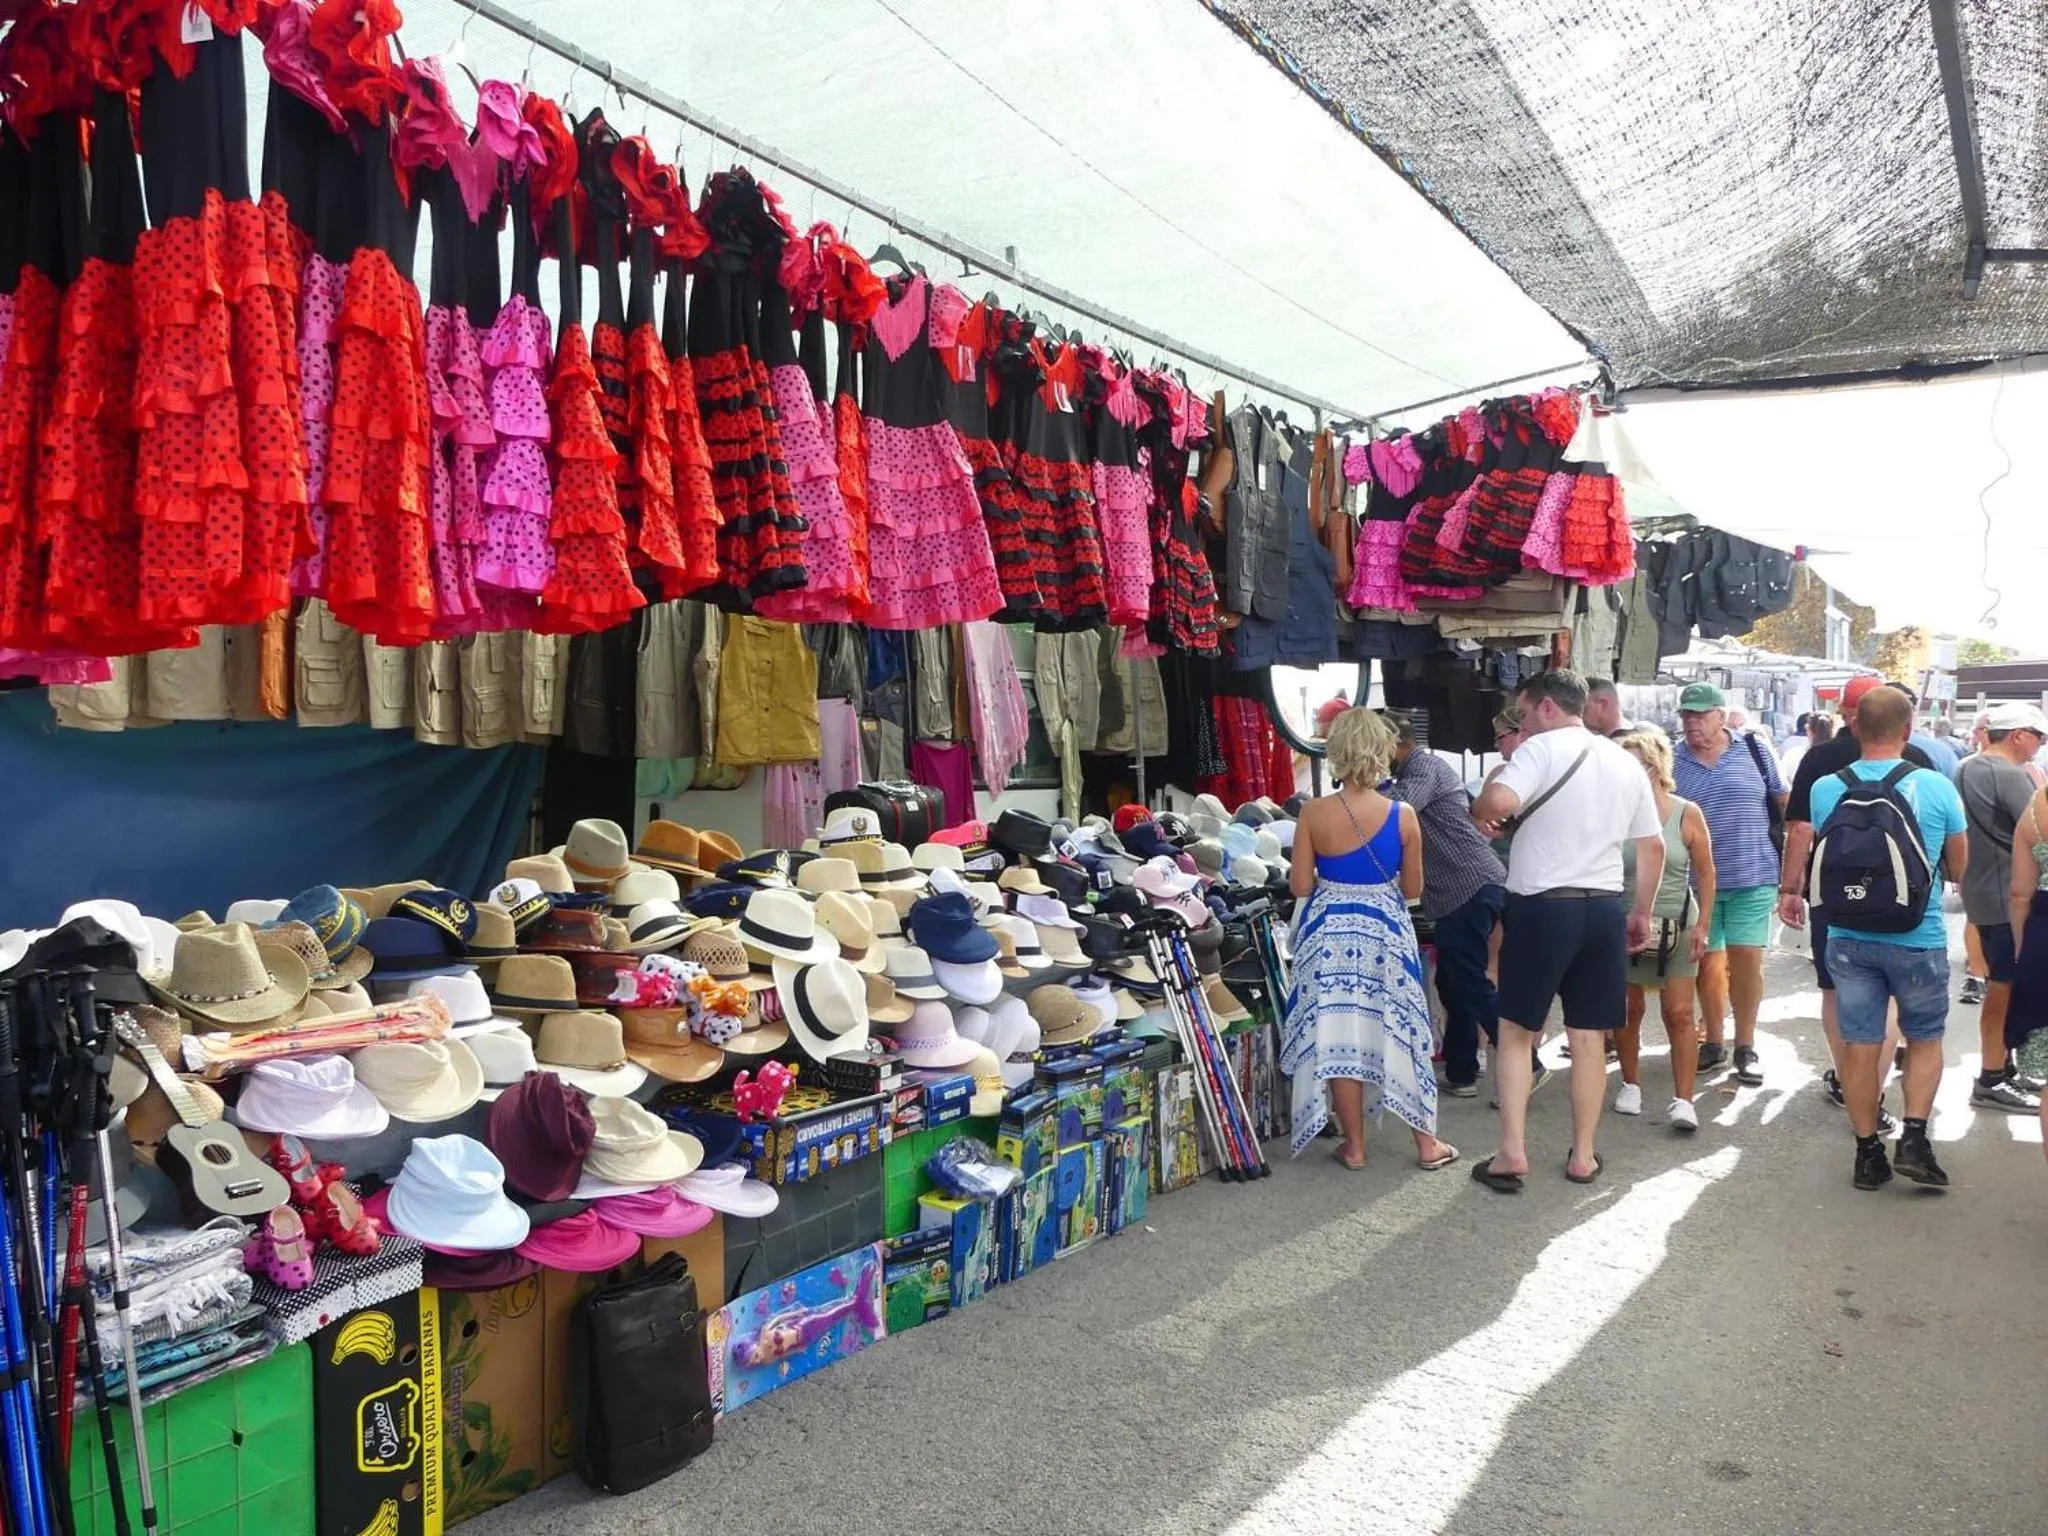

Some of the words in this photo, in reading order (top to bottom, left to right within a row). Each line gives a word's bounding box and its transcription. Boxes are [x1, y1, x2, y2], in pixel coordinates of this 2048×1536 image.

[797, 1115, 842, 1143] DARTBOARD
[842, 1105, 873, 1127] MAGNET
[422, 1310, 435, 1378] BANANAS
[373, 1401, 398, 1458] Orsero
[424, 1385, 437, 1443] QUALITY
[426, 1445, 438, 1516] PREMIUM
